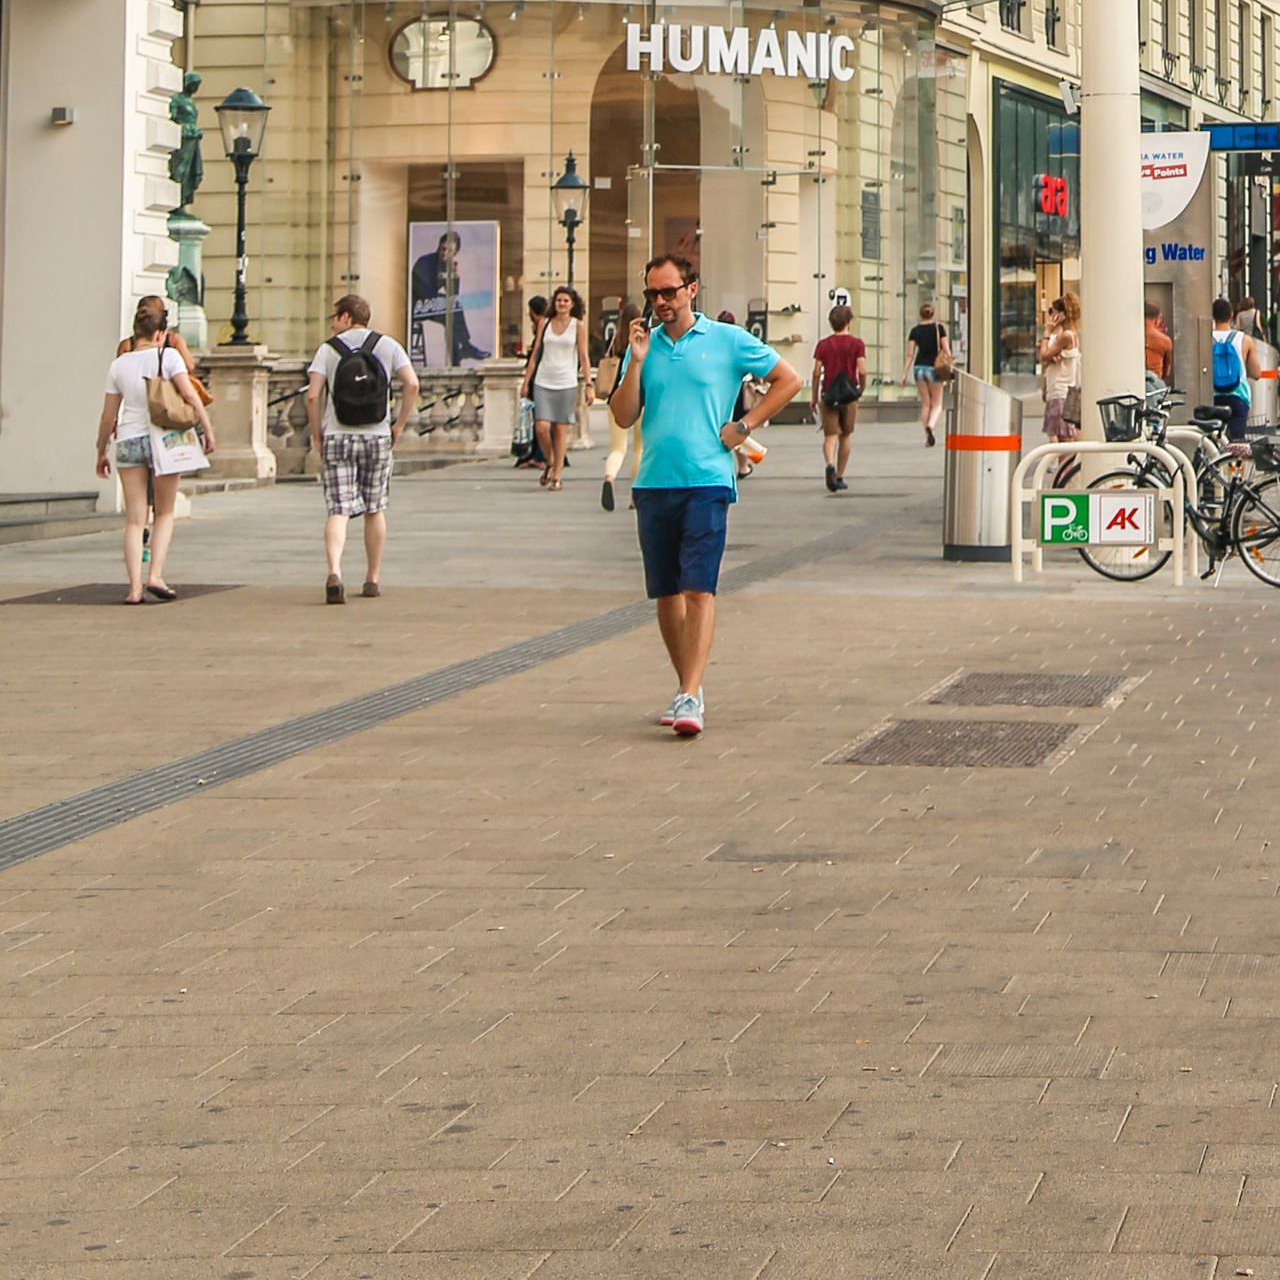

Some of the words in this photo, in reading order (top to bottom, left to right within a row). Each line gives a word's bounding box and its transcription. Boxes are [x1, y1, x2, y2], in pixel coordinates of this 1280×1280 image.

[626, 22, 855, 82] HUMANIC
[1152, 152, 1184, 160] WATER
[1154, 168, 1184, 178] Points
[1041, 173, 1068, 217] ara
[1161, 243, 1206, 262] Water
[1044, 498, 1077, 541] P
[1105, 508, 1140, 530] AK
